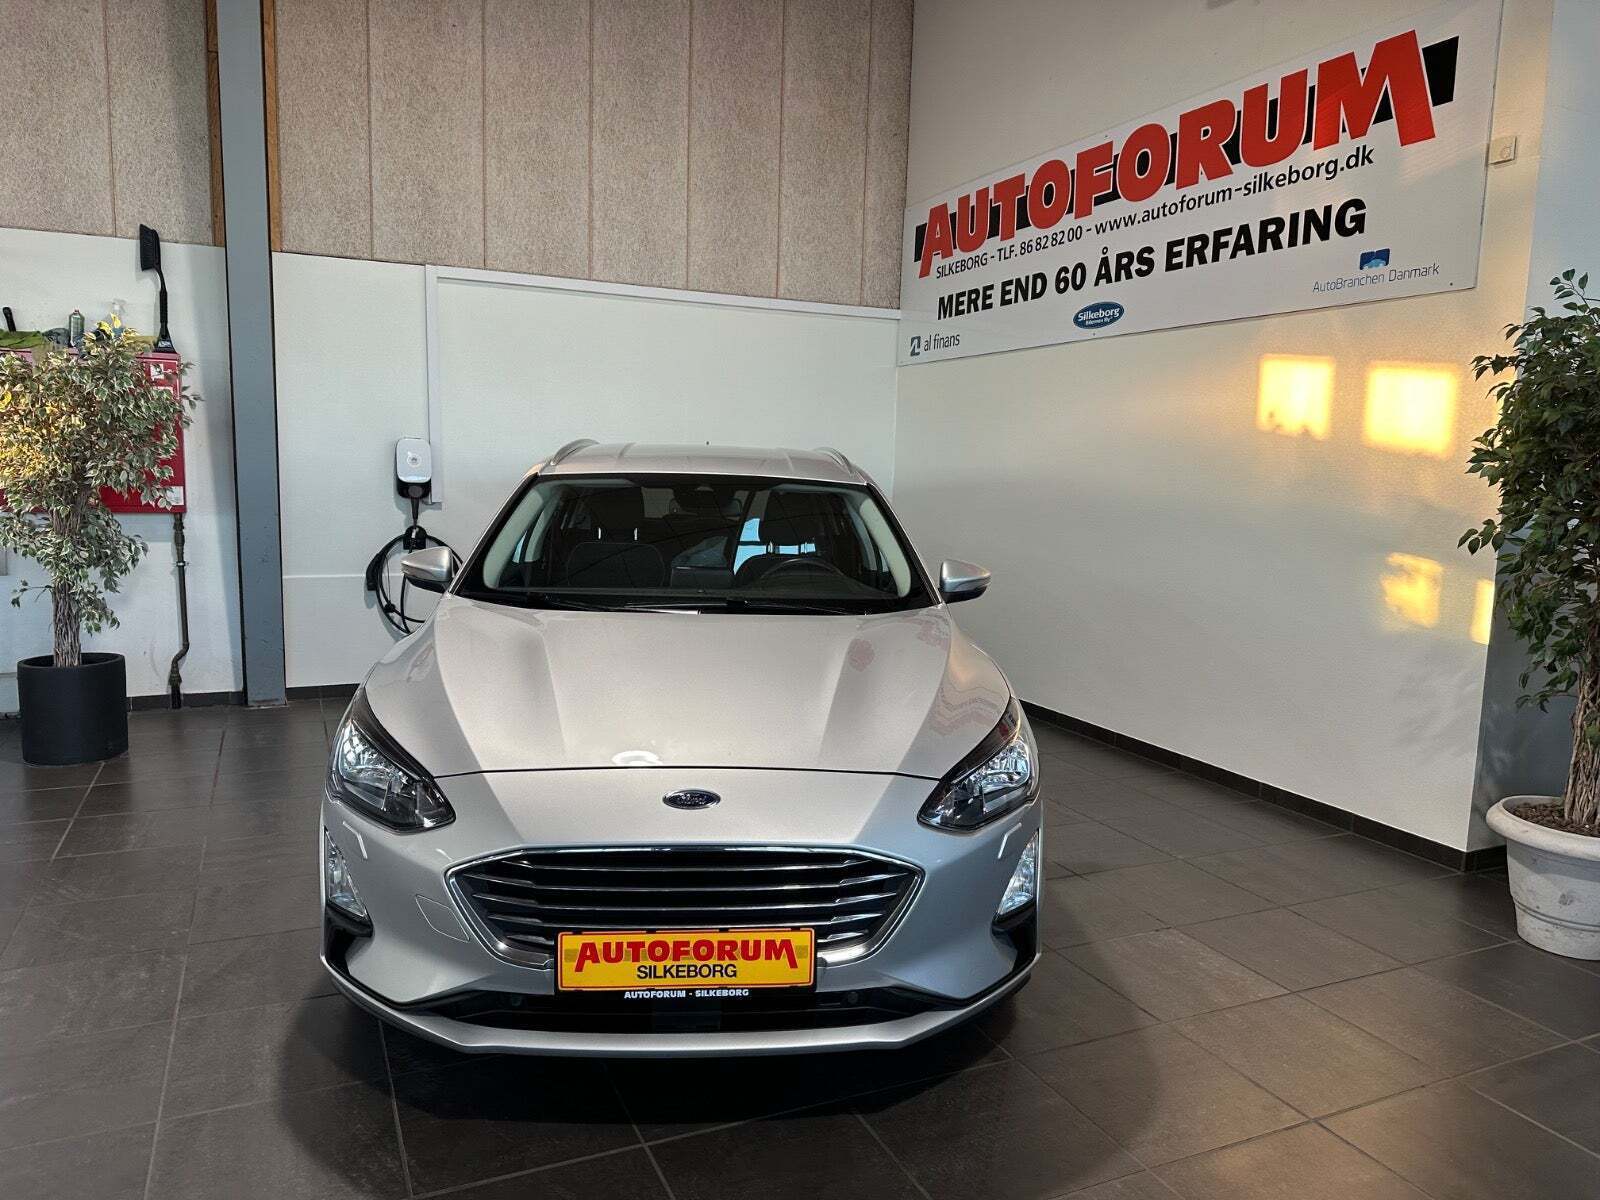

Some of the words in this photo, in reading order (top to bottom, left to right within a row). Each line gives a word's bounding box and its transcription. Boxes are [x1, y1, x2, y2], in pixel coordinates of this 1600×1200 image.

[919, 29, 1436, 278] AUTOFORUM
[936, 252, 988, 279] SILKEBORG
[997, 245, 1018, 262] TLF.
[1095, 145, 1374, 236] www.autoforum-silkeborg.dk
[937, 283, 994, 321] MERE
[1000, 271, 1047, 308] END
[1055, 262, 1086, 295] 60
[1094, 245, 1155, 287] ÅRS
[1165, 198, 1368, 273] ERFARING
[1312, 270, 1385, 294] AutoBranchen
[1388, 262, 1440, 283] Danmark
[1078, 307, 1120, 322] Silkeborg
[924, 334, 932, 352] al
[933, 333, 960, 350] finans
[574, 938, 798, 972] AUTOFORUM
[636, 964, 737, 980] SILKEBORG
[624, 990, 686, 999] AUTOFORUM
[695, 988, 749, 997] SILKEBORG
